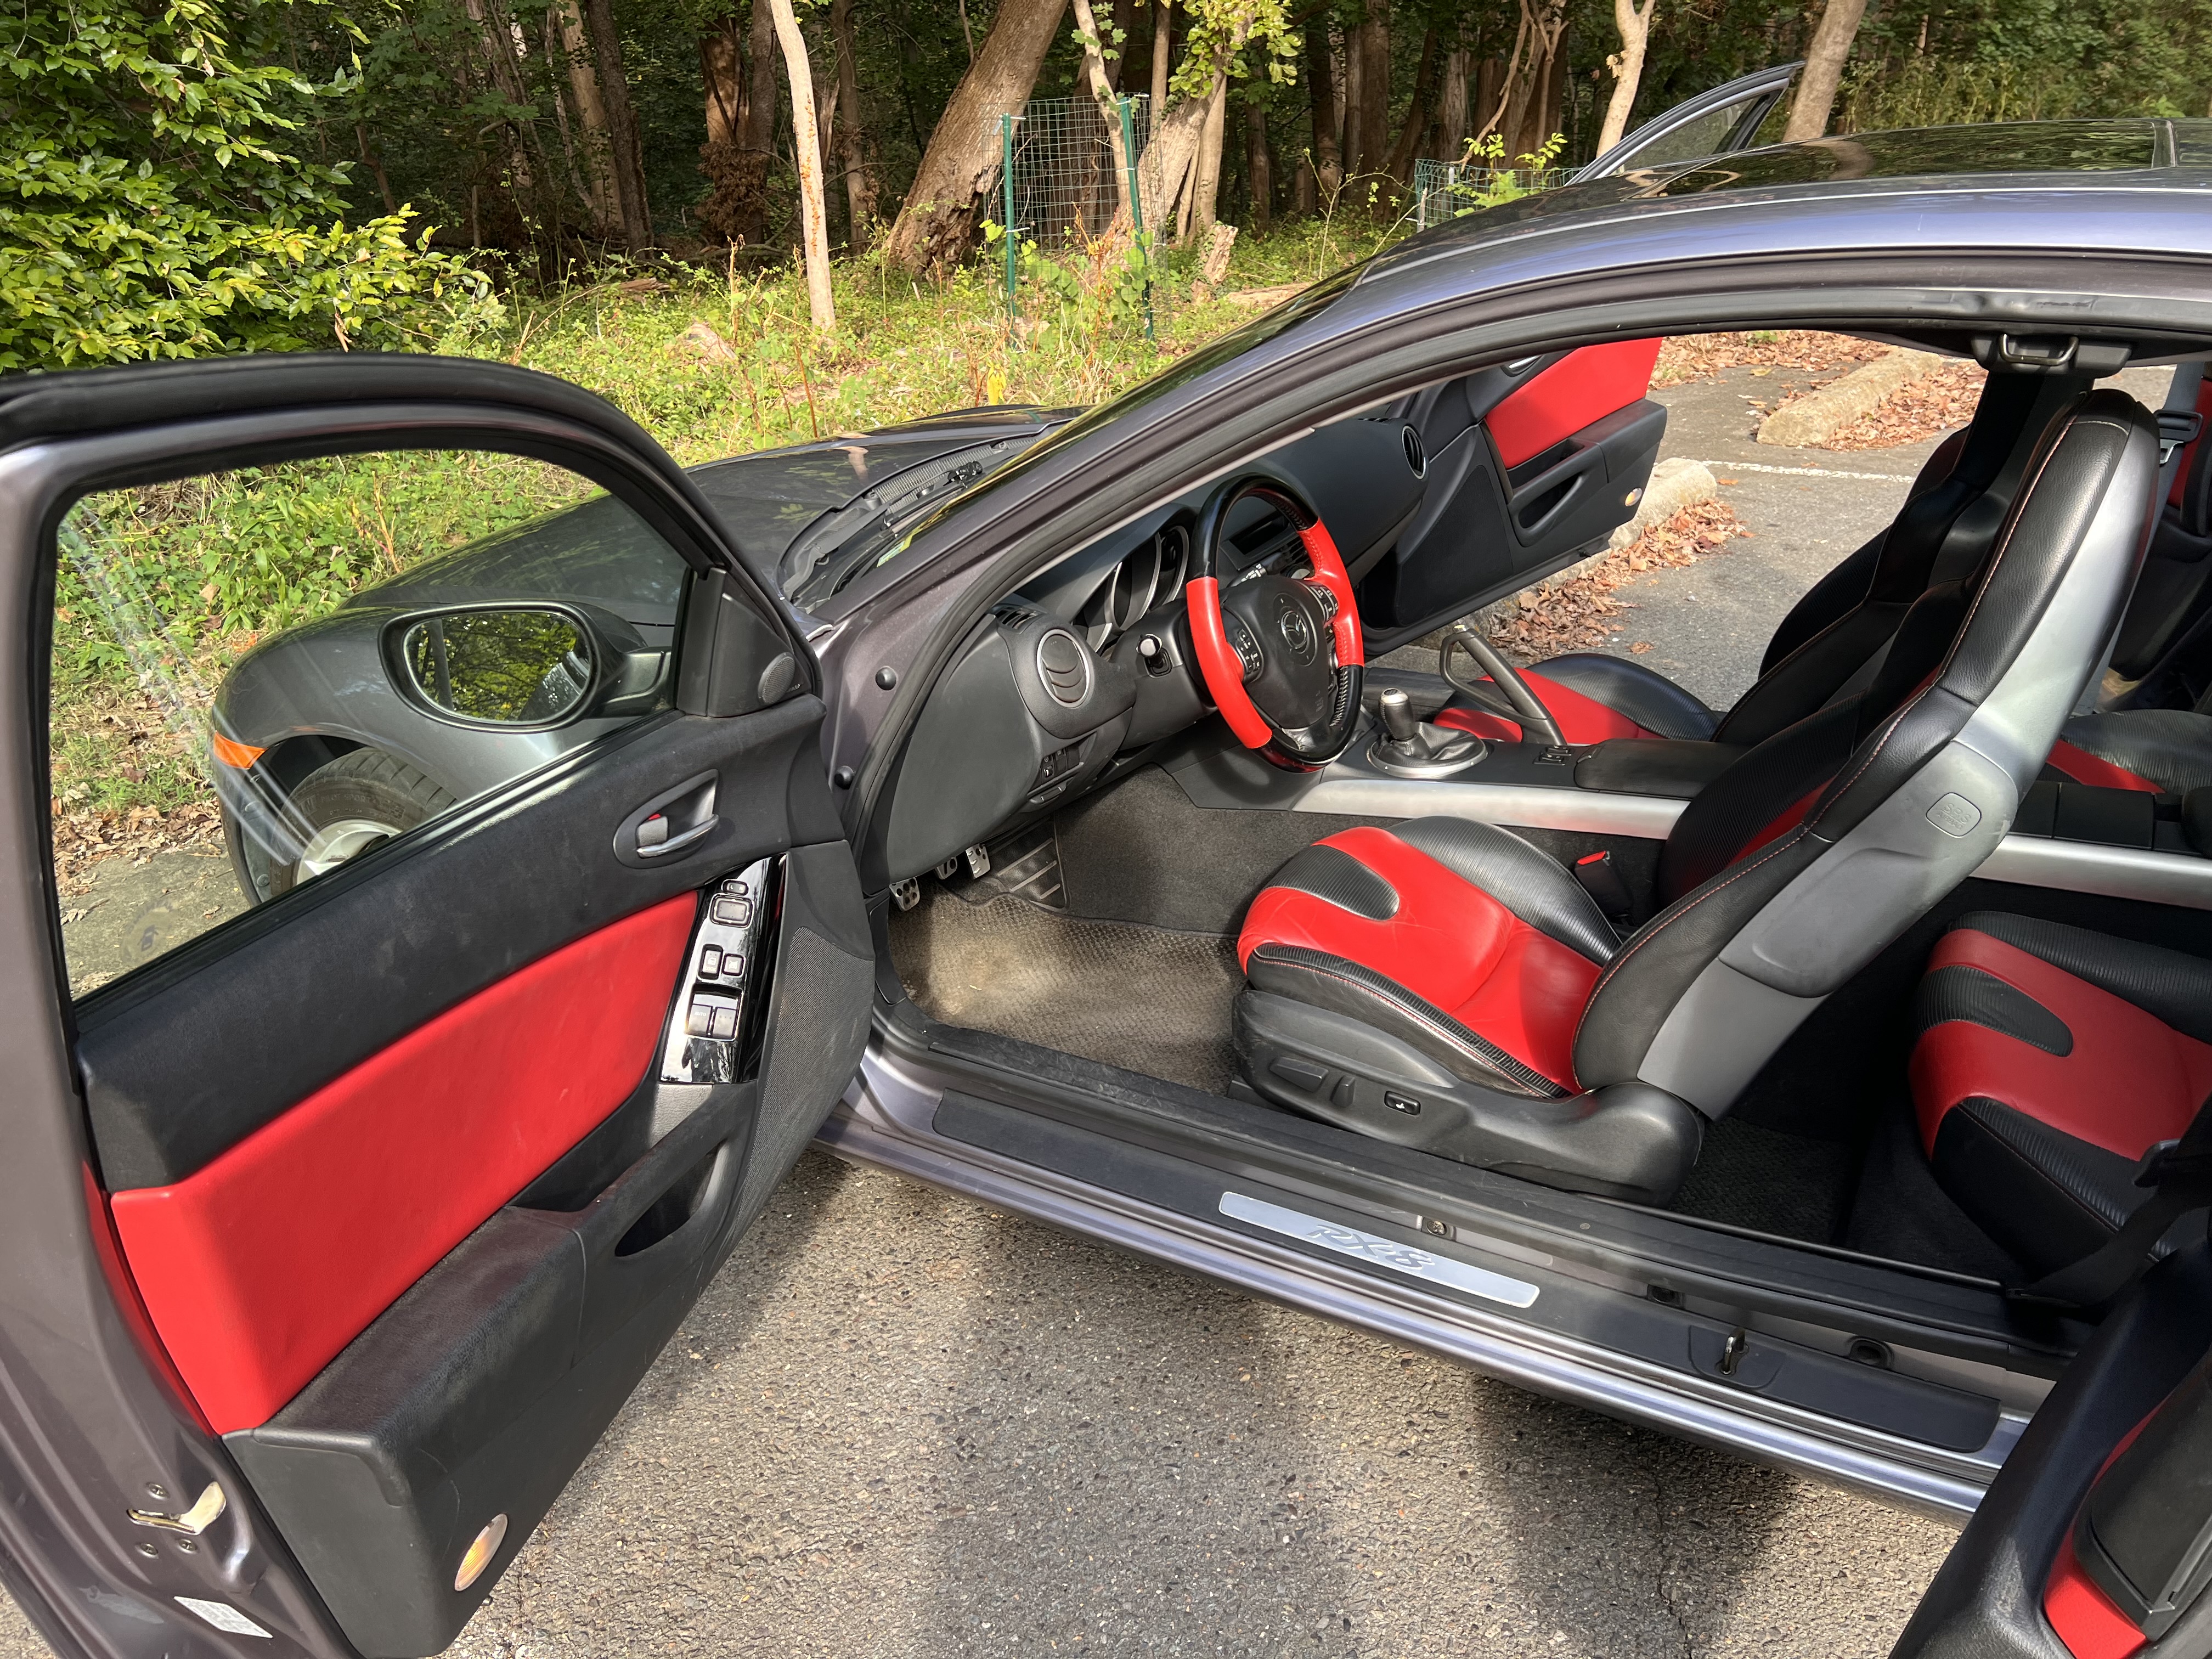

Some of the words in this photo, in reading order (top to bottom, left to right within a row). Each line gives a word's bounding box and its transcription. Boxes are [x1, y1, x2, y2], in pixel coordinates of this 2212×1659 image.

[343, 793, 371, 803] SPORT
[1944, 803, 1972, 824] SRS
[1306, 1224, 1435, 1270] RX-8
